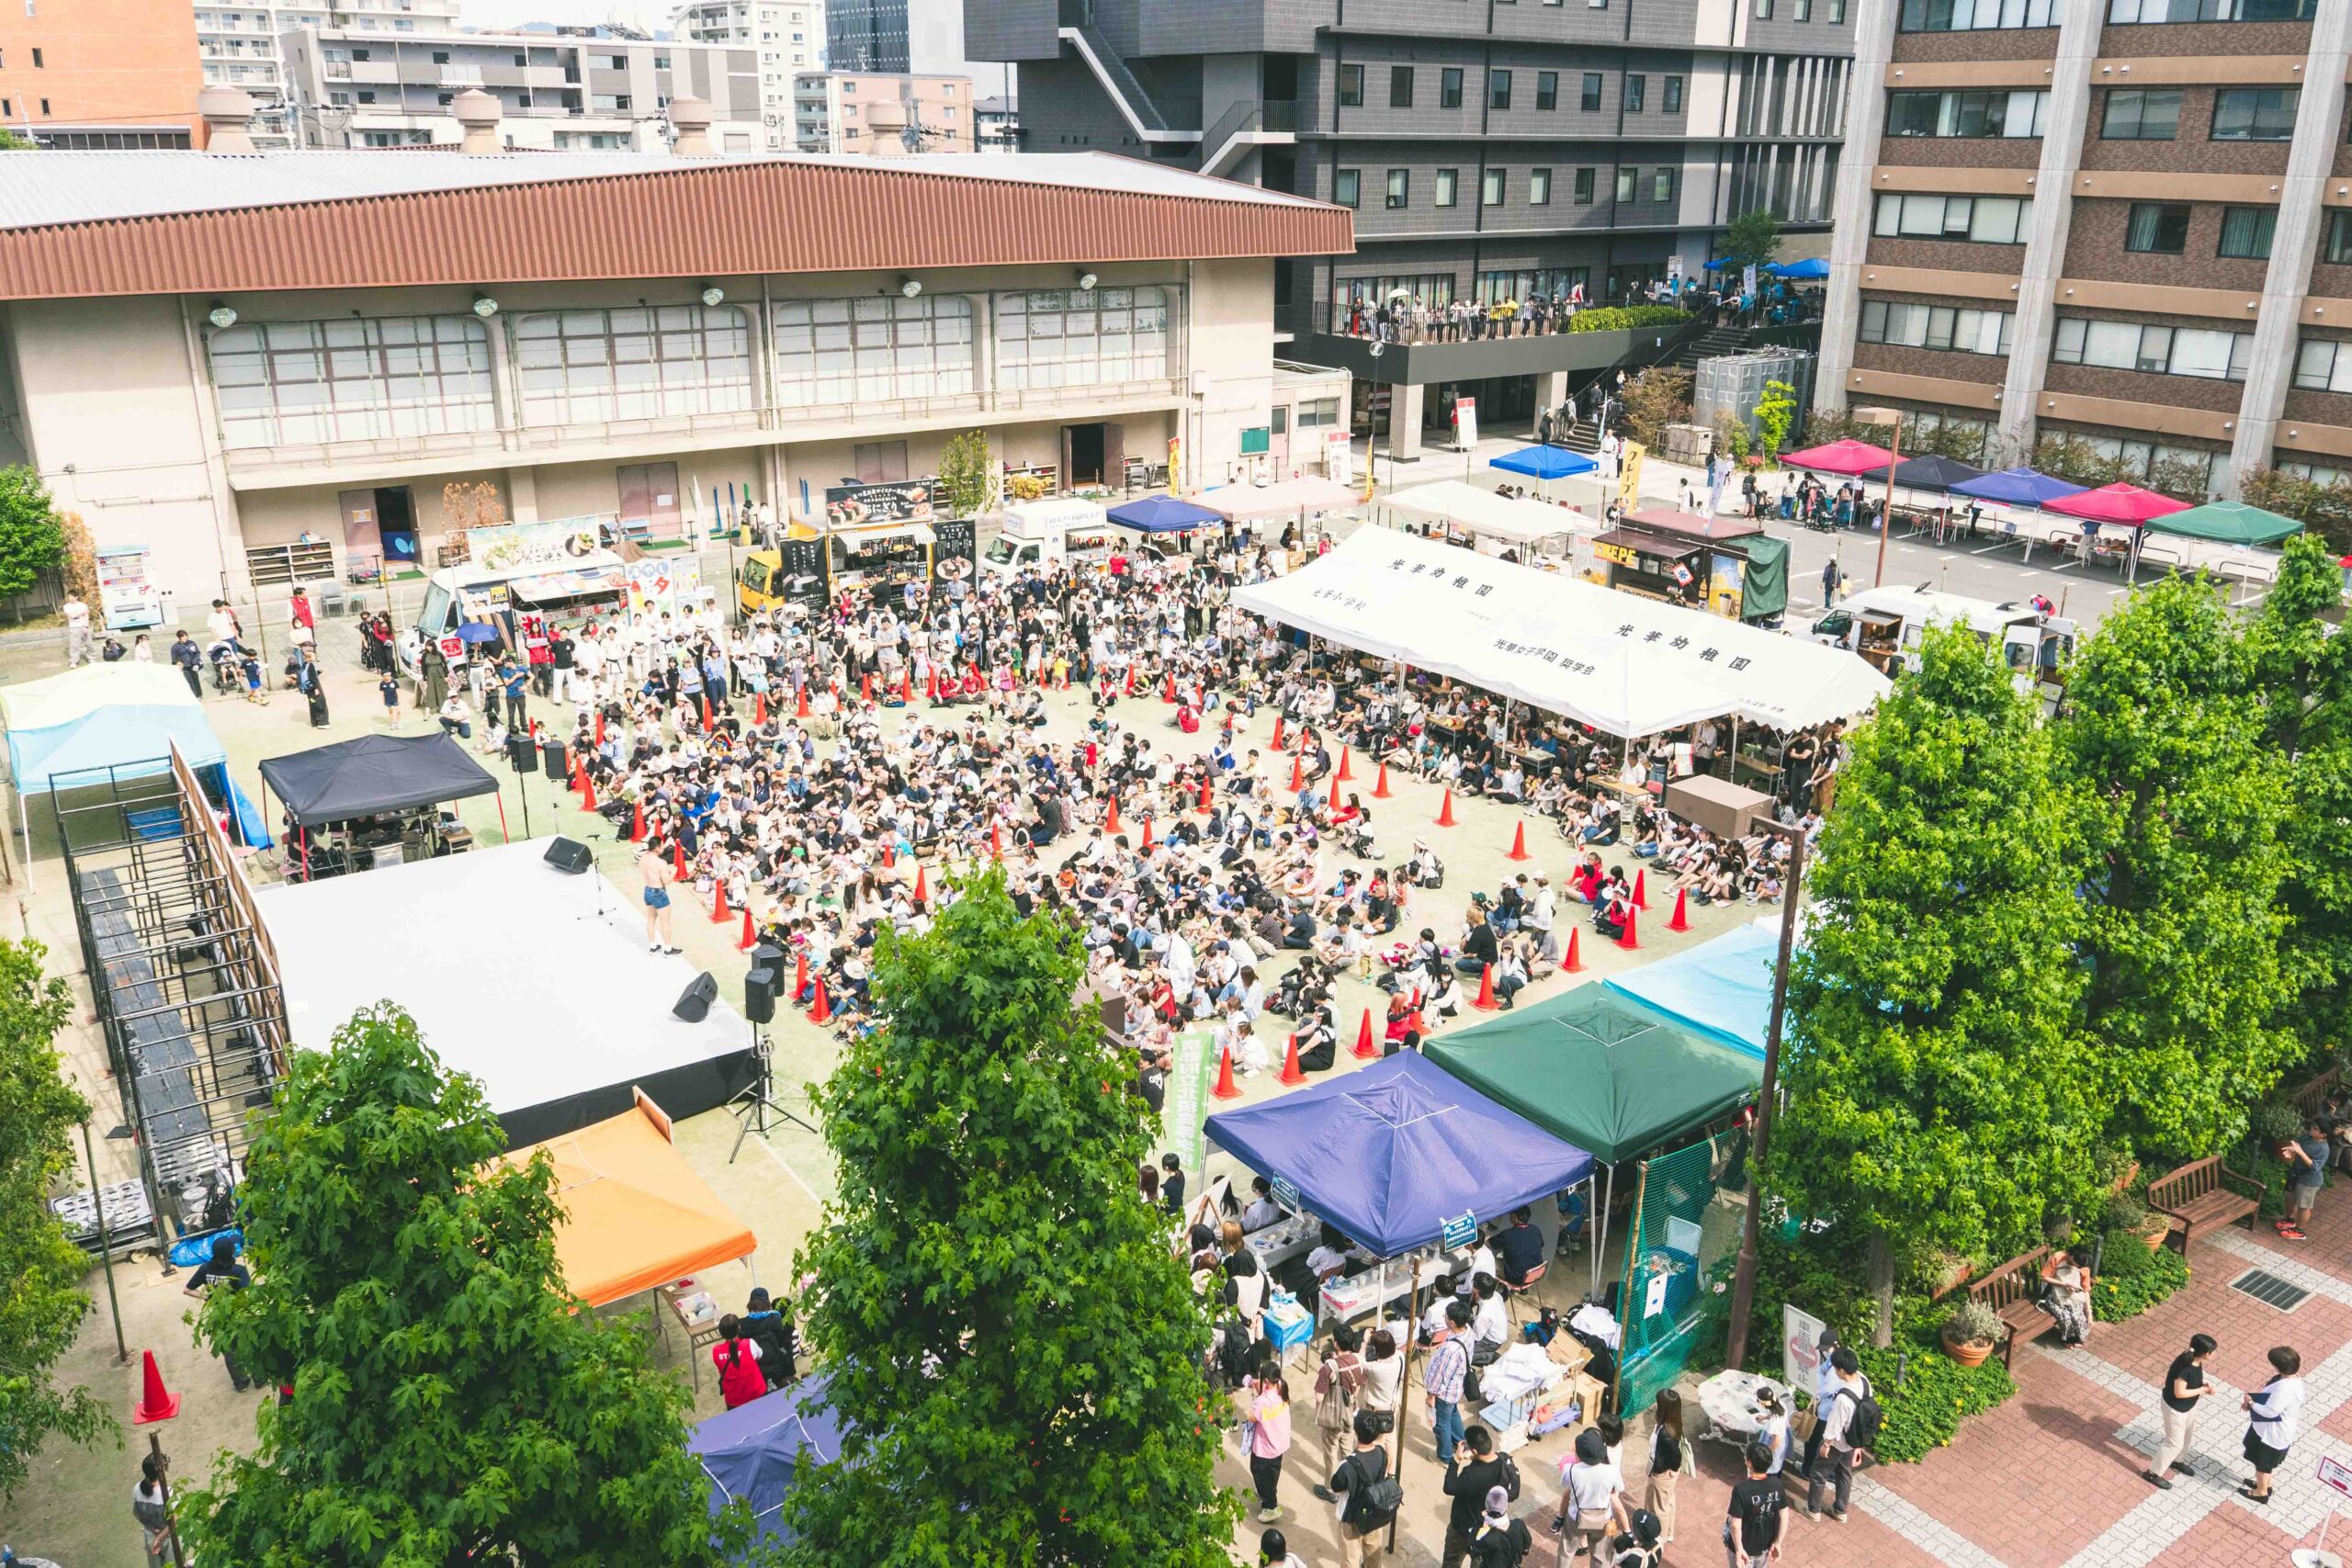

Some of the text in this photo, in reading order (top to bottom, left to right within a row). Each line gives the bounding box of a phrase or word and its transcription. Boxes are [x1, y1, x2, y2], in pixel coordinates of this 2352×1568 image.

[1623, 450, 1638, 494] クレープ
[865, 502, 898, 514] おにぎり
[940, 531, 969, 540] おにぎり
[1388, 558, 1494, 597] 光華幼稚園
[1493, 638, 1559, 663] 光華女子学園
[1614, 624, 1751, 671] 光華幼稚園
[718, 1350, 742, 1360] STF
